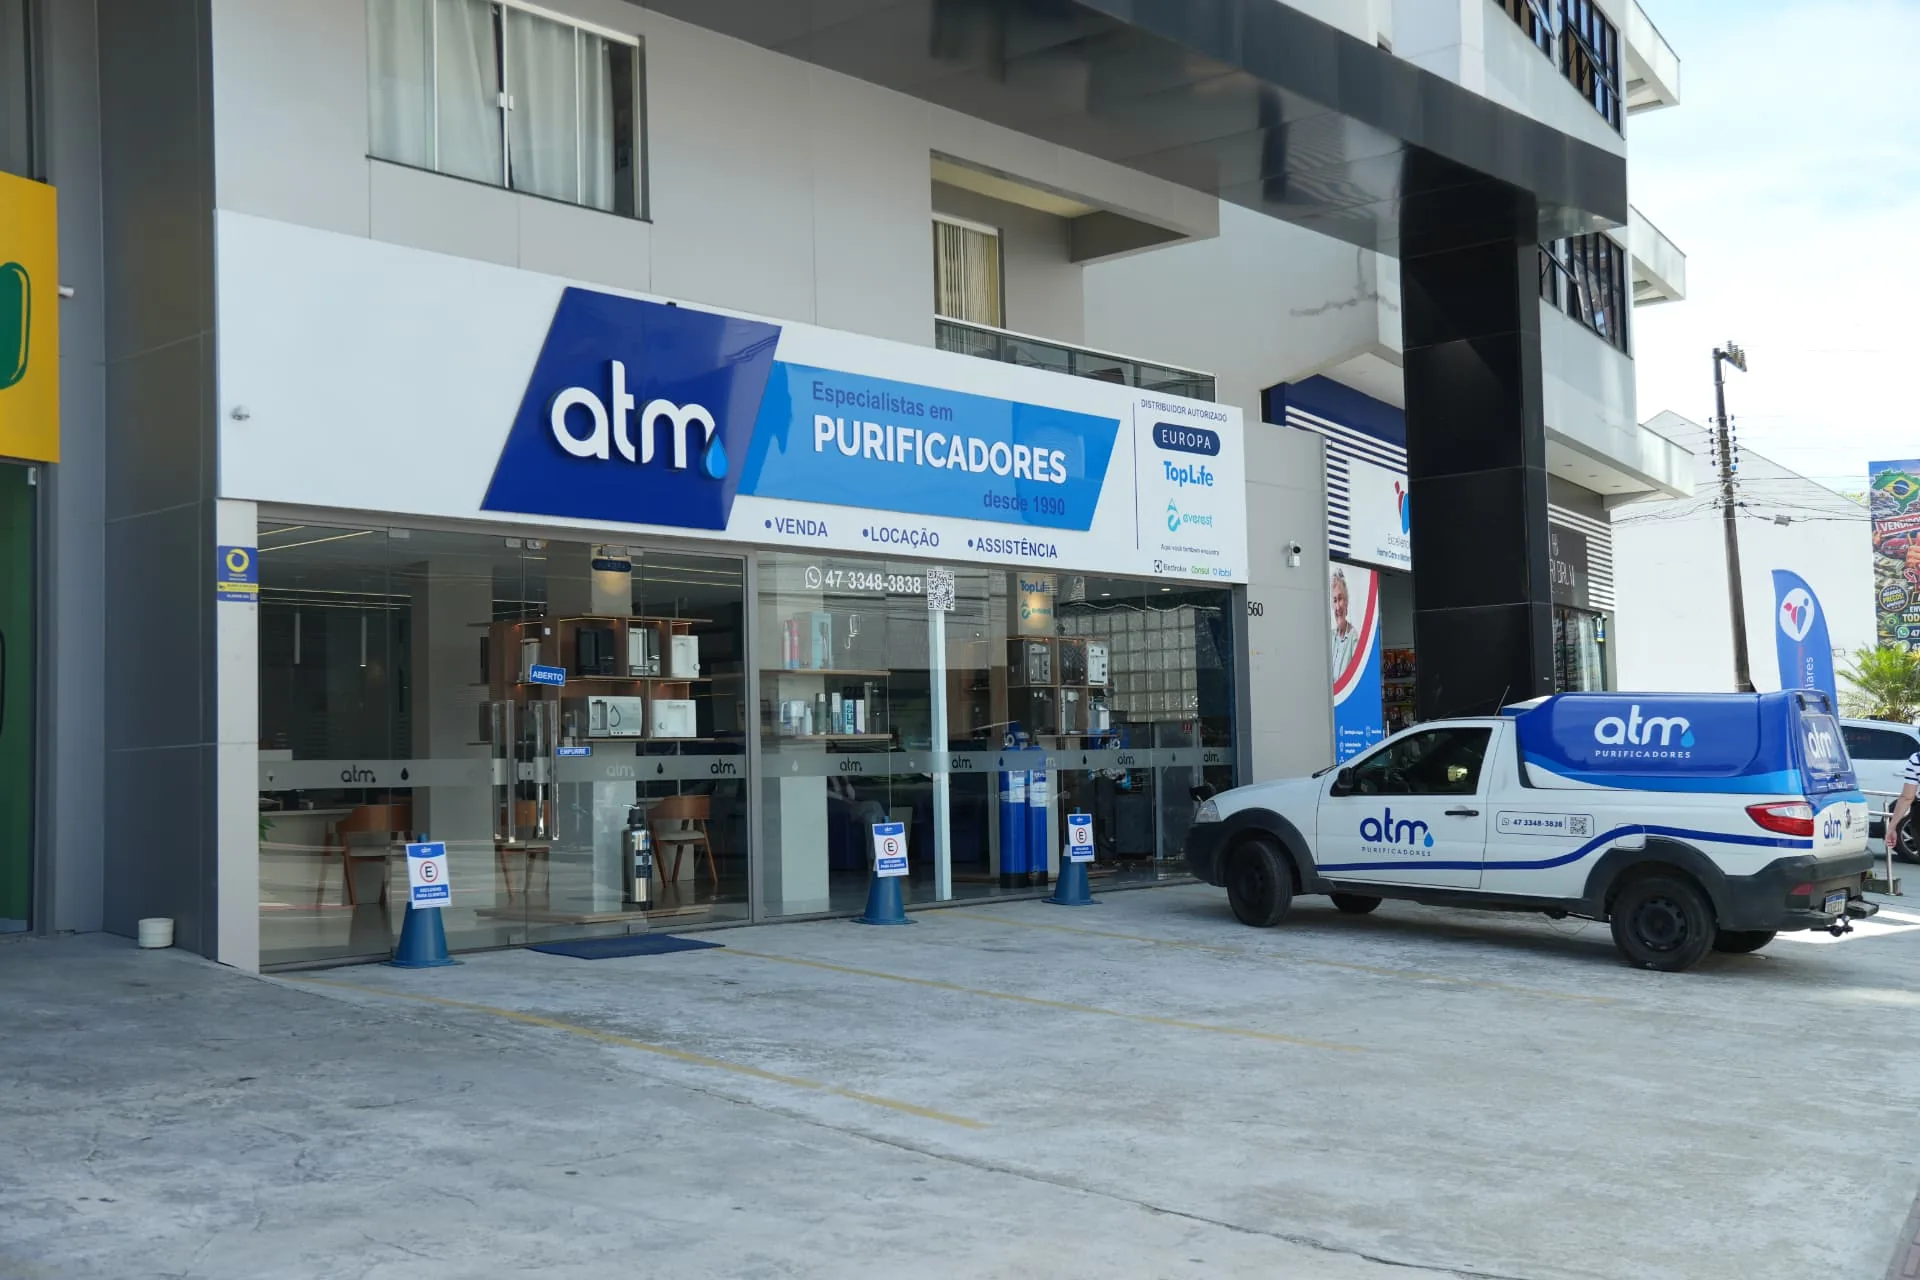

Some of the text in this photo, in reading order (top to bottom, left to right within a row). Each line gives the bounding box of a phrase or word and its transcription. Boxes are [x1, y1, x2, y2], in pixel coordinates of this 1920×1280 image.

[812, 381, 953, 422] Especialistas em
[1141, 399, 1228, 422] DISTRIBUIDOR AUTORIZADO
[551, 360, 716, 468] atm
[1162, 429, 1212, 450] EUROPA
[813, 414, 1068, 485] PURIFICADORES
[1163, 460, 1214, 488] TopLife
[983, 489, 1065, 516] desde 1990
[775, 517, 828, 537] VENDA
[1182, 512, 1213, 529] everest
[871, 526, 940, 549] LOCAÇÃO
[976, 537, 1058, 559] ASSISTÊNCIA
[1191, 566, 1210, 575] Consul
[825, 570, 921, 593] 47 3348-3838
[1247, 601, 1264, 617] 560
[532, 670, 563, 682] ABERTO
[1594, 704, 1691, 746] atm
[1808, 721, 1832, 759] atm
[952, 755, 971, 769] atm
[1117, 752, 1136, 766] atm
[1203, 751, 1219, 763] atm
[1595, 750, 1691, 758] PURIFICADORES
[341, 764, 375, 783] atm
[711, 758, 736, 775] atm
[840, 756, 862, 772] atm
[1360, 807, 1428, 845] atm
[1823, 811, 1842, 840] atm
[1079, 831, 1084, 841] E
[888, 842, 895, 852] E
[1361, 846, 1432, 856] PURIFICADORES
[425, 865, 434, 878] E
